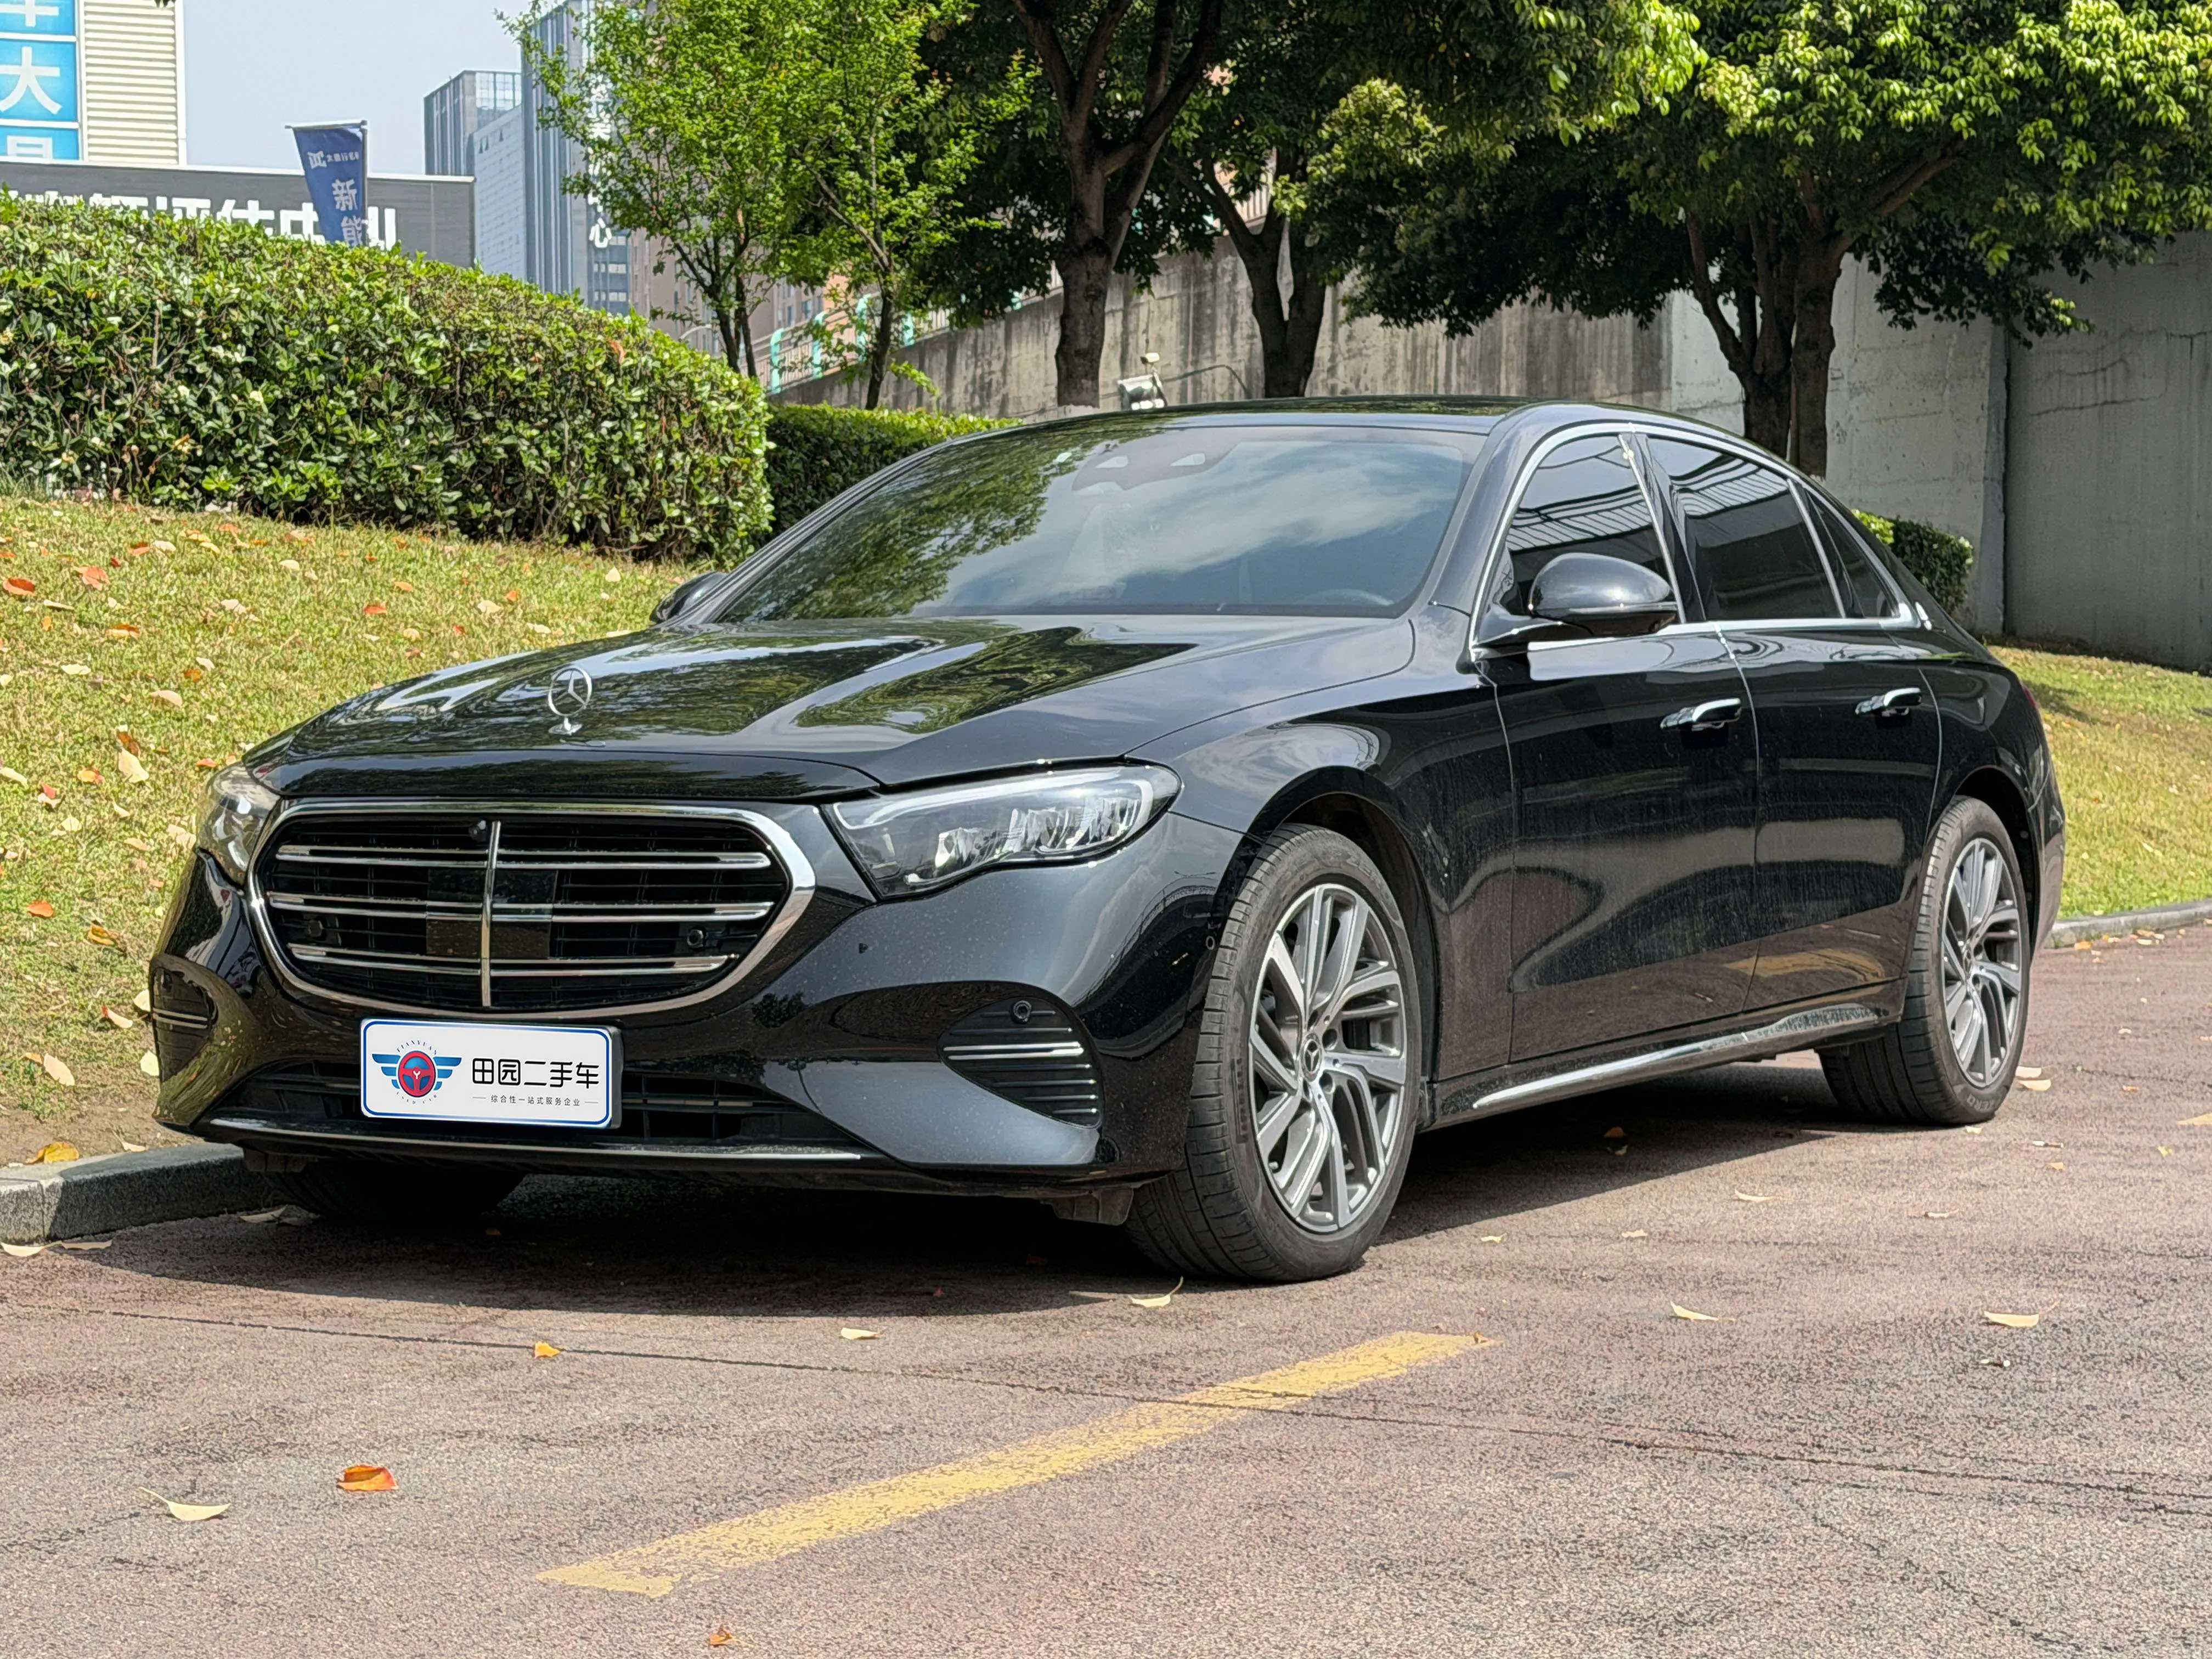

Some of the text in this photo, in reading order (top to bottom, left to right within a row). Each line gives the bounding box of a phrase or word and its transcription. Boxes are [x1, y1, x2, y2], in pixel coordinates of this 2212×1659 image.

[472, 1058, 599, 1088] 田园二手车
[490, 1094, 580, 1107] 综合性一站式服务企业
